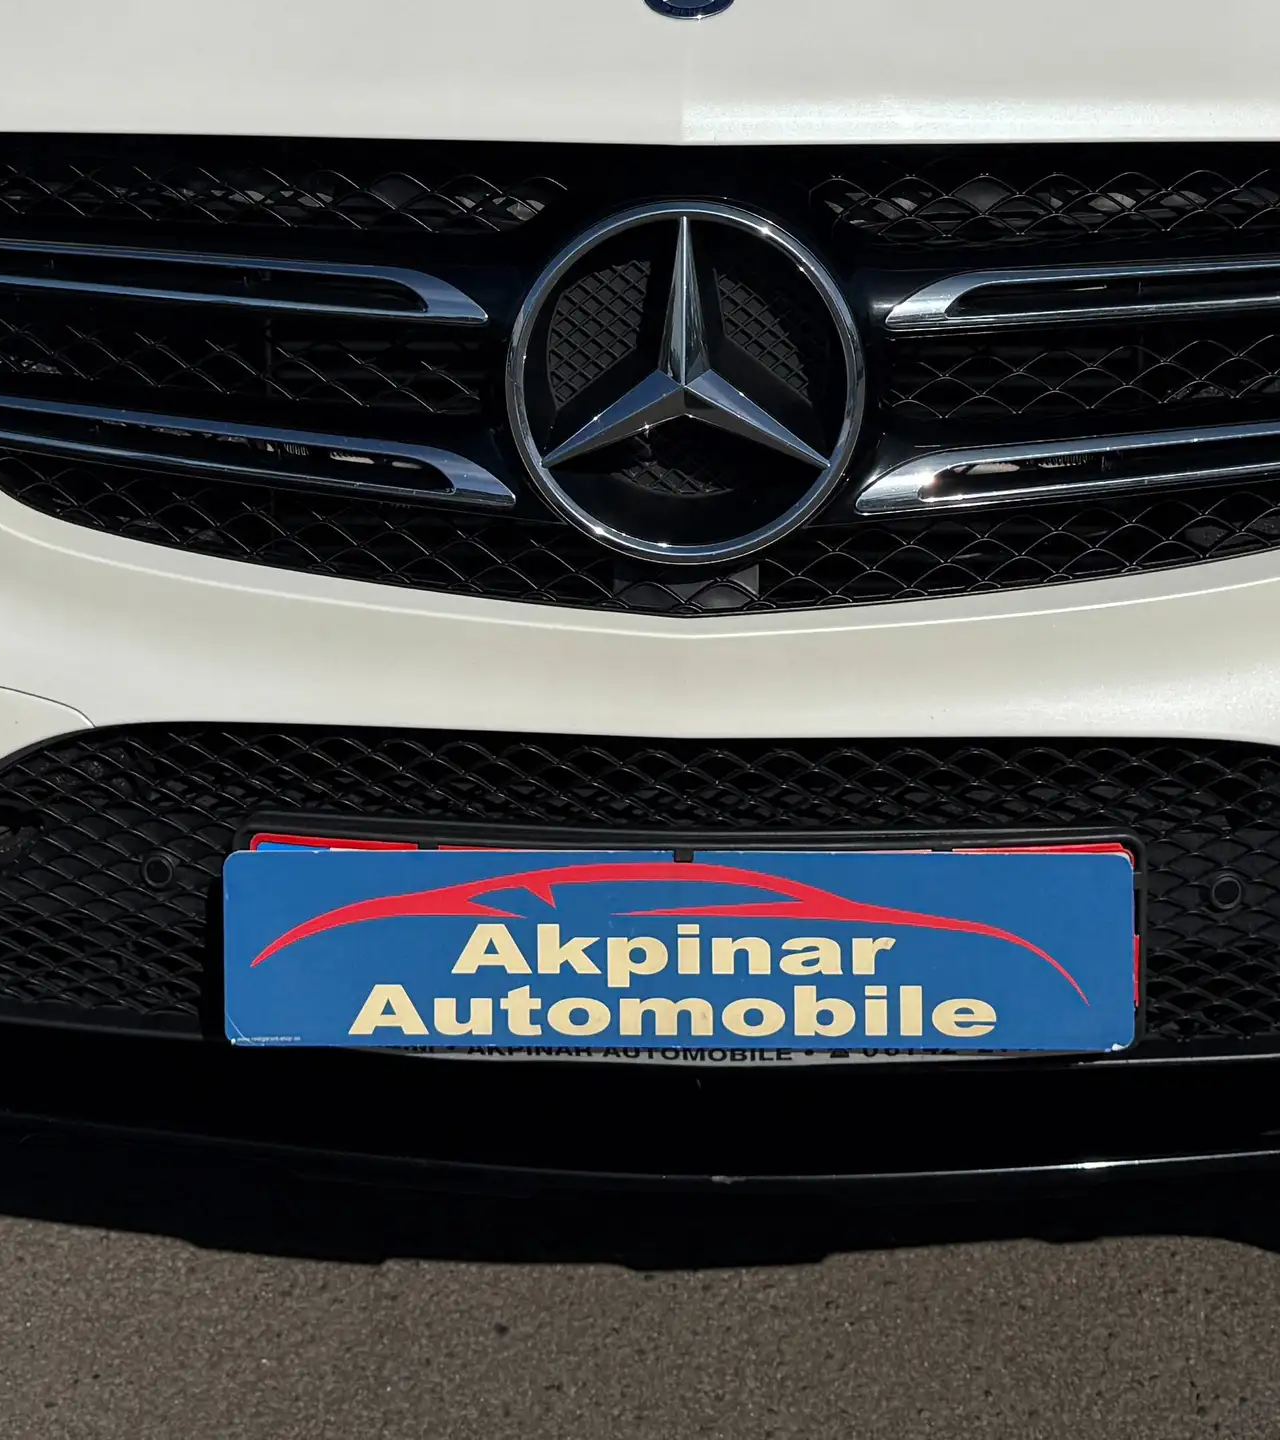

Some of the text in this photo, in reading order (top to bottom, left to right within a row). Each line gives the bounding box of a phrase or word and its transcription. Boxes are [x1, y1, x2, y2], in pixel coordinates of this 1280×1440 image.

[451, 923, 896, 988] Akpinar
[347, 984, 998, 1038] Automobile
[603, 1047, 793, 1062] AUTOMOBILE
